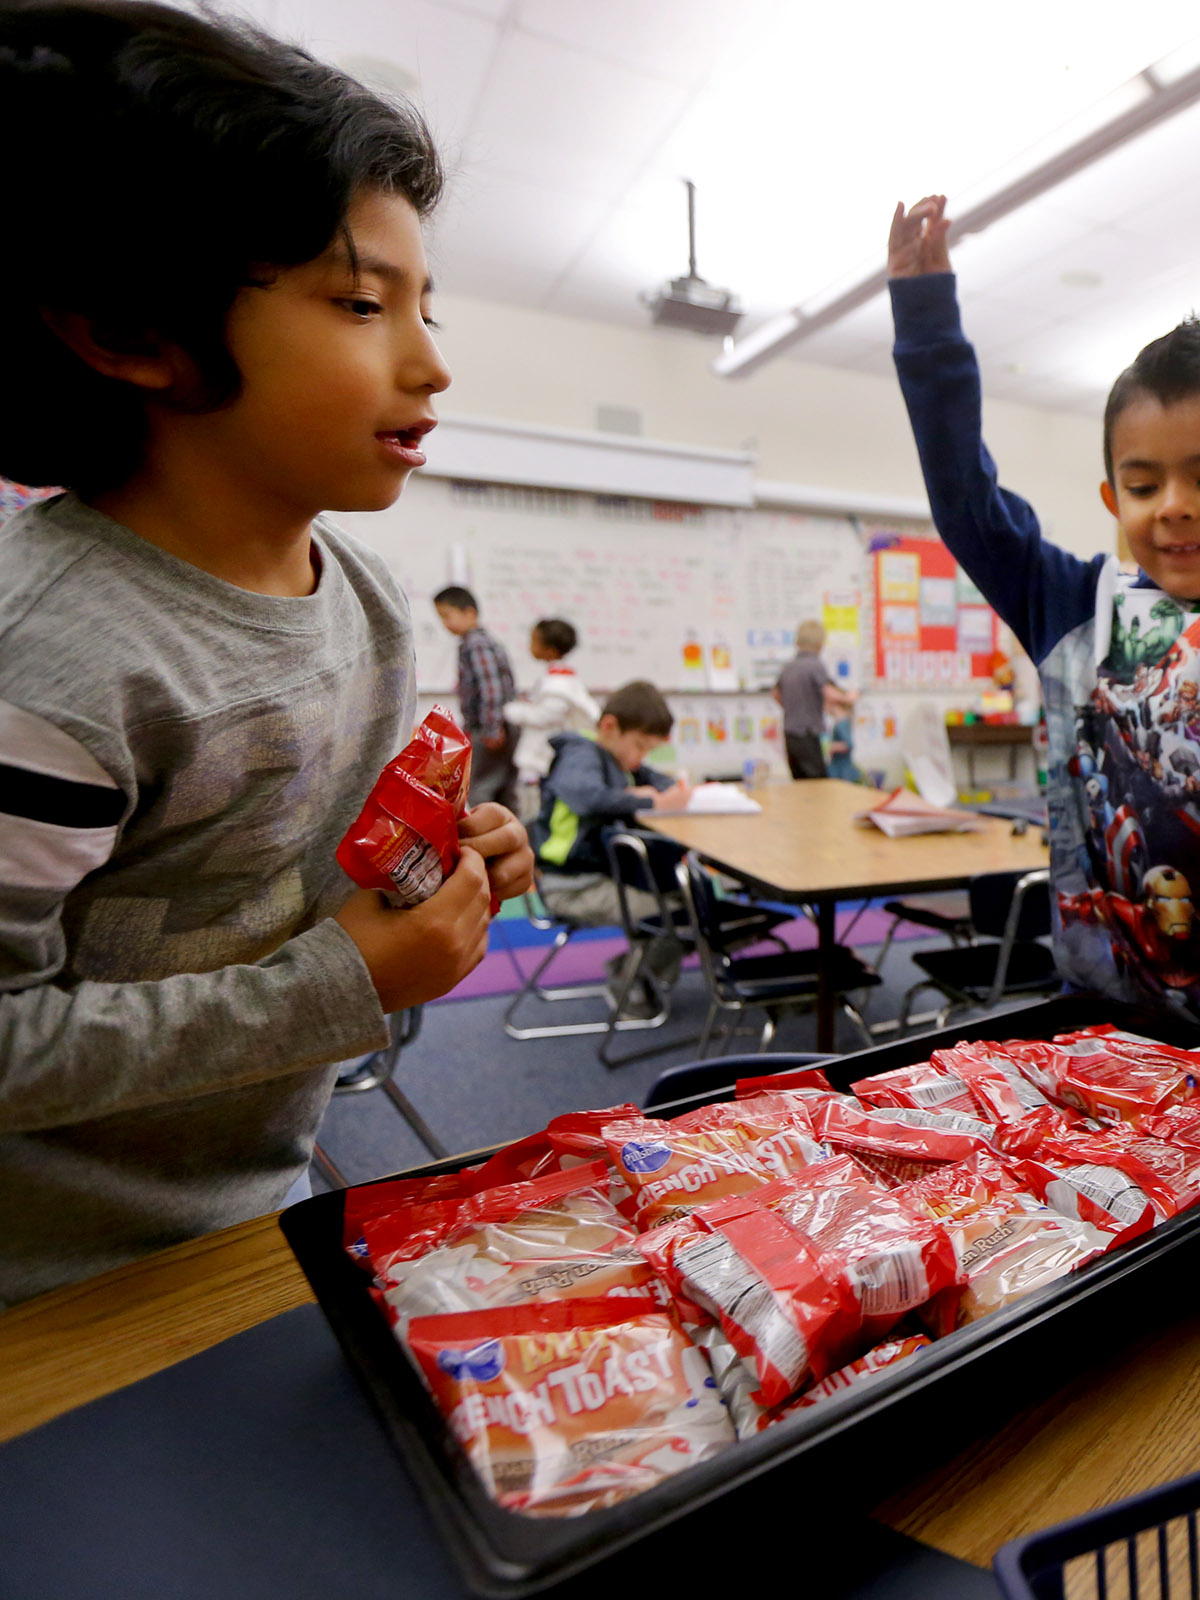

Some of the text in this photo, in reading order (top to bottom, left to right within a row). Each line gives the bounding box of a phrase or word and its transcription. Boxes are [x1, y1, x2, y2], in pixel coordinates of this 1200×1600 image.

[637, 1128, 797, 1209] RENCH TOAST
[972, 1226, 1014, 1253] Rush
[548, 1340, 674, 1415] TOAST
